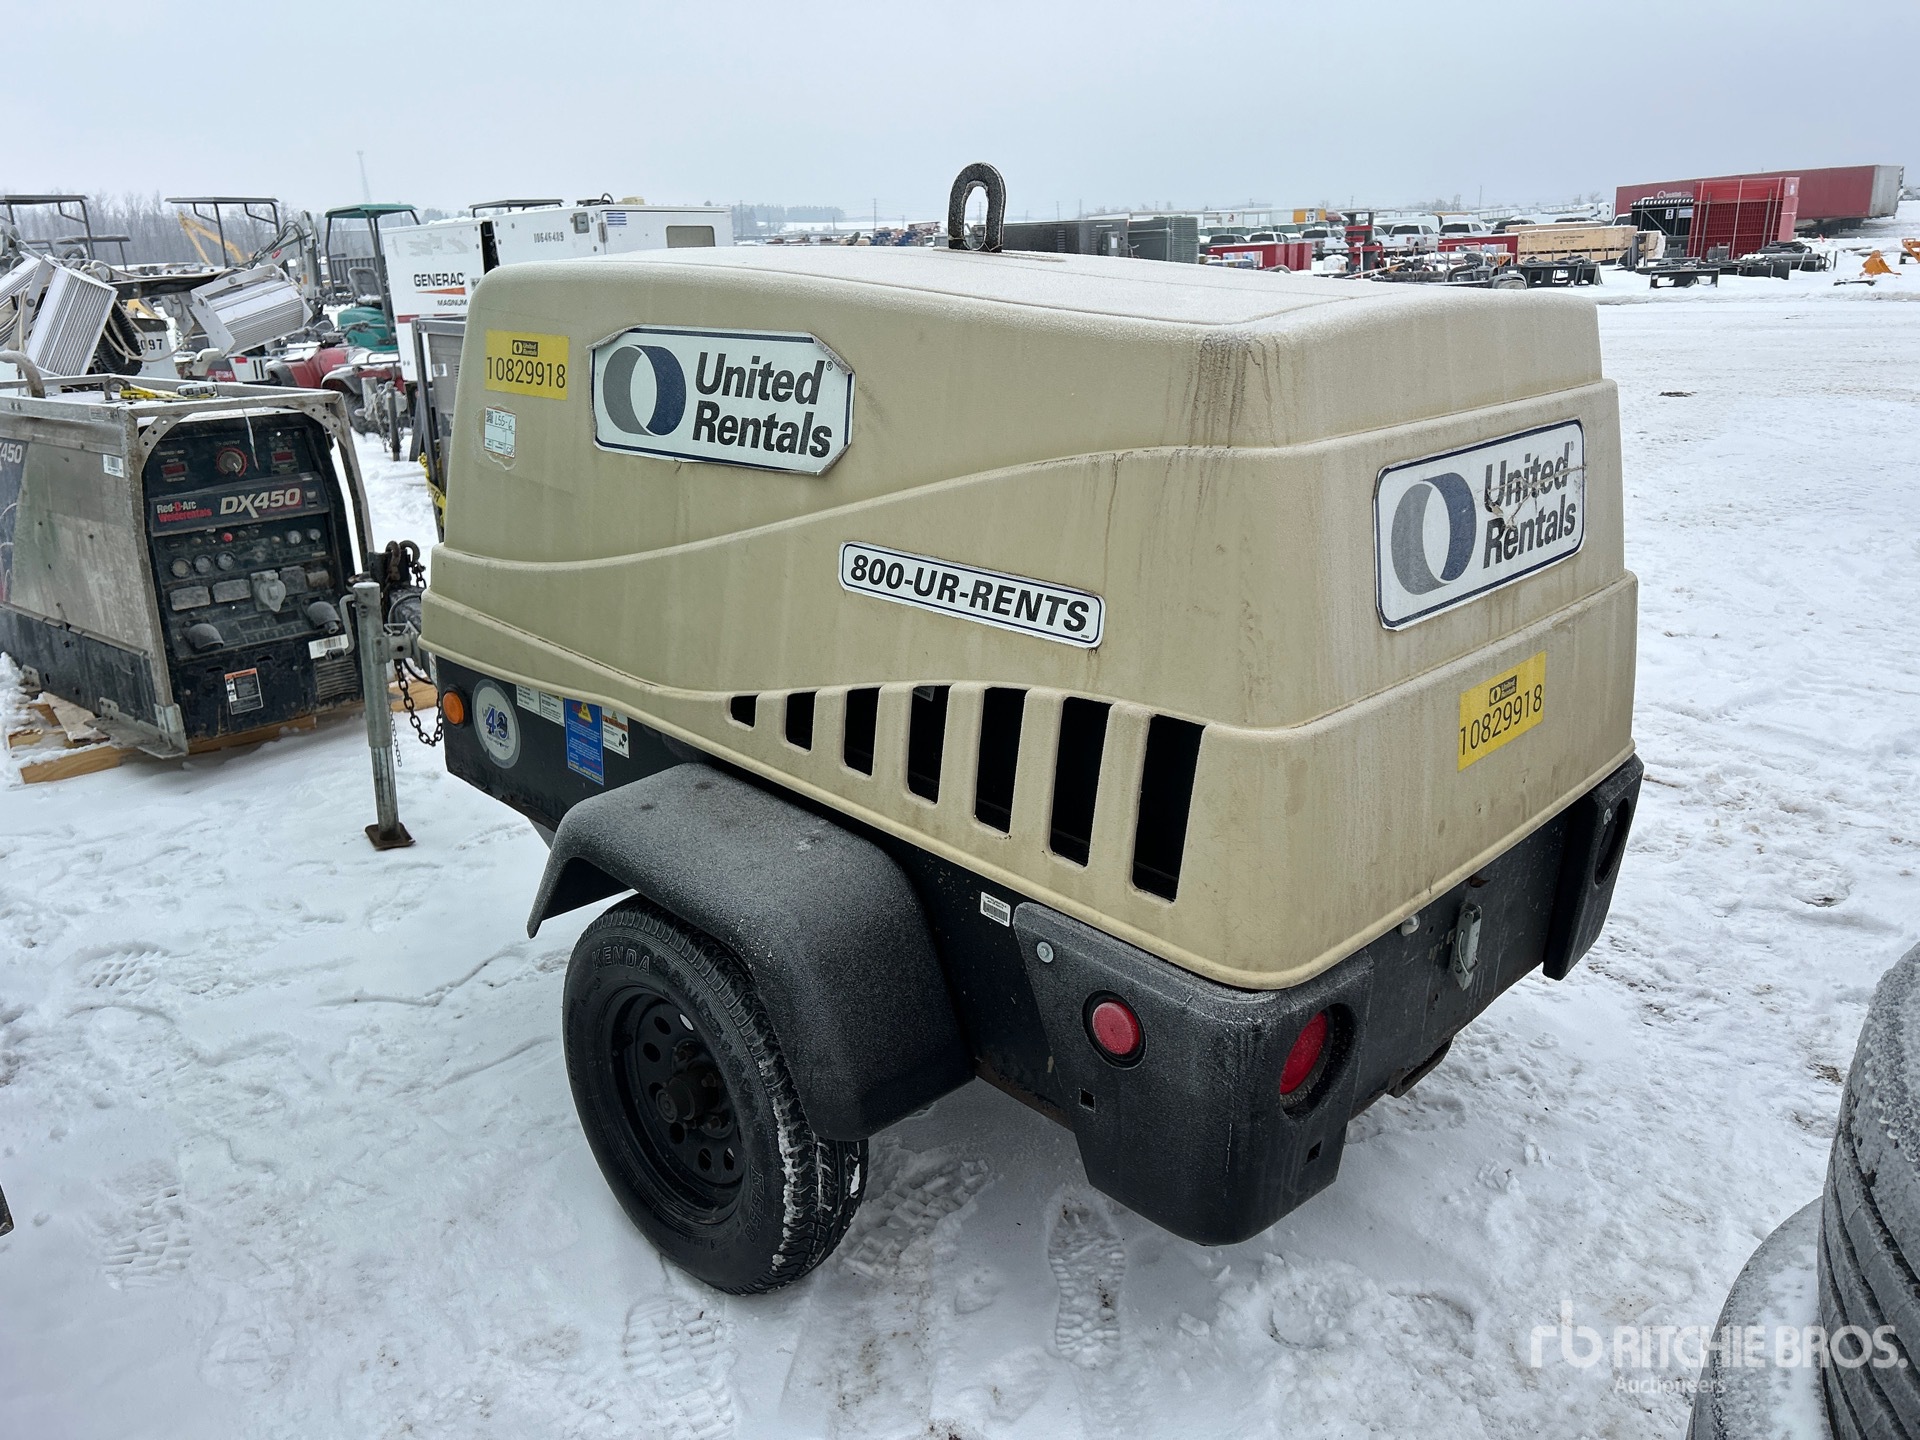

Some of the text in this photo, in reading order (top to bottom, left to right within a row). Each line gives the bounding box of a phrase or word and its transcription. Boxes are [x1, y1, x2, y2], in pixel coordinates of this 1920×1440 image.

[413, 272, 465, 287] GENERAC
[486, 356, 566, 389] 10829918
[695, 351, 826, 406] United
[692, 400, 833, 459] Rentals
[219, 487, 301, 519] DX450
[1483, 441, 1571, 513] United
[156, 500, 197, 514] Red-D-Arc
[1482, 494, 1577, 569] Rentals
[850, 553, 1090, 633] 800-UR-RENTS
[1460, 683, 1543, 756] 10829918
[591, 945, 650, 976] KENDA
